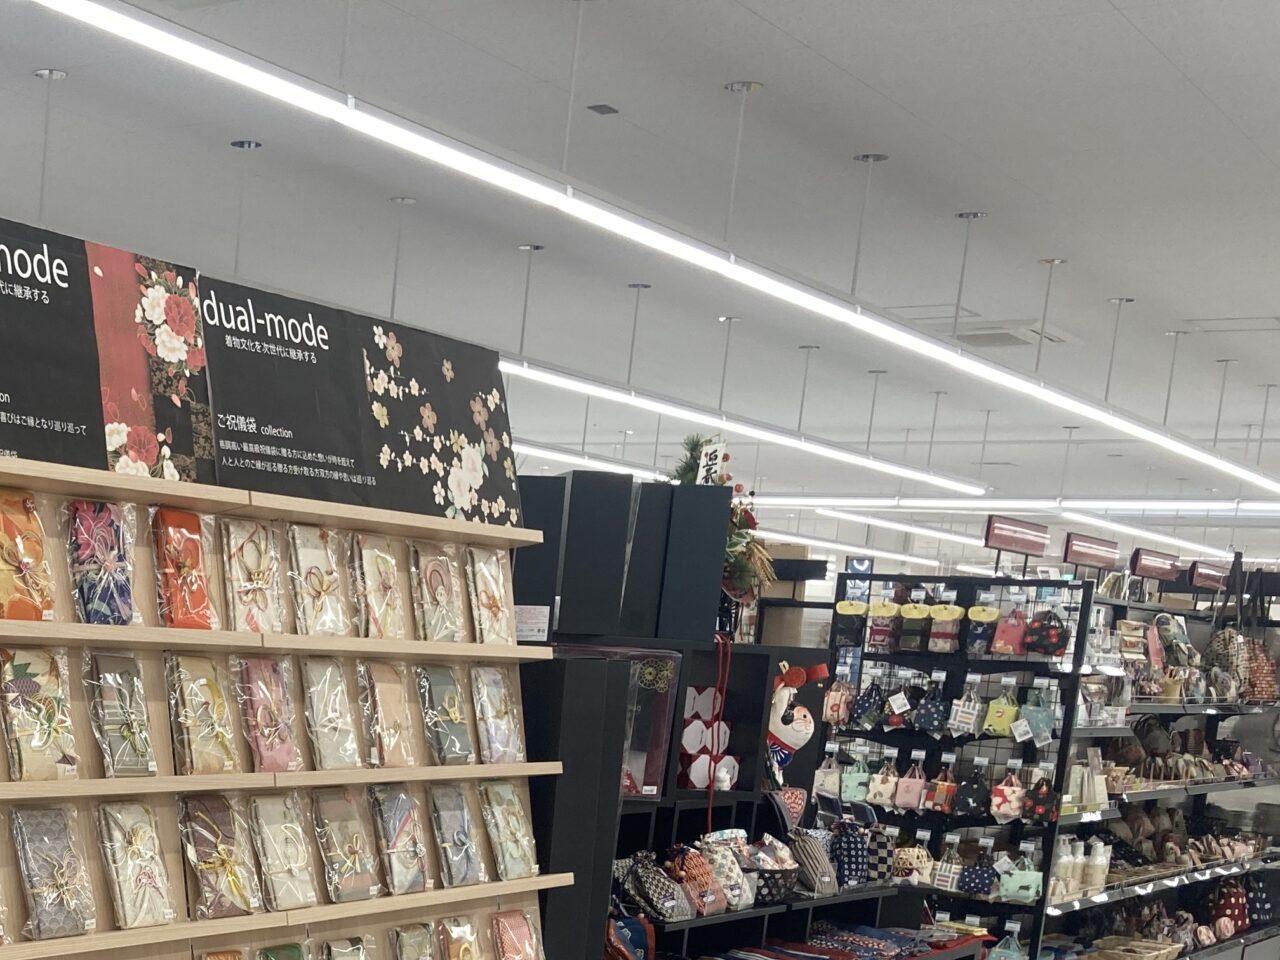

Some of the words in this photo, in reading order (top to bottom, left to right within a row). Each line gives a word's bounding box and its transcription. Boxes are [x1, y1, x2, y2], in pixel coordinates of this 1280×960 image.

[202, 290, 329, 350] dual-mode
[224, 334, 317, 364] 着物文化を次世代に継承する
[217, 413, 257, 434] ご祝儀袋
[261, 425, 293, 439] collection
